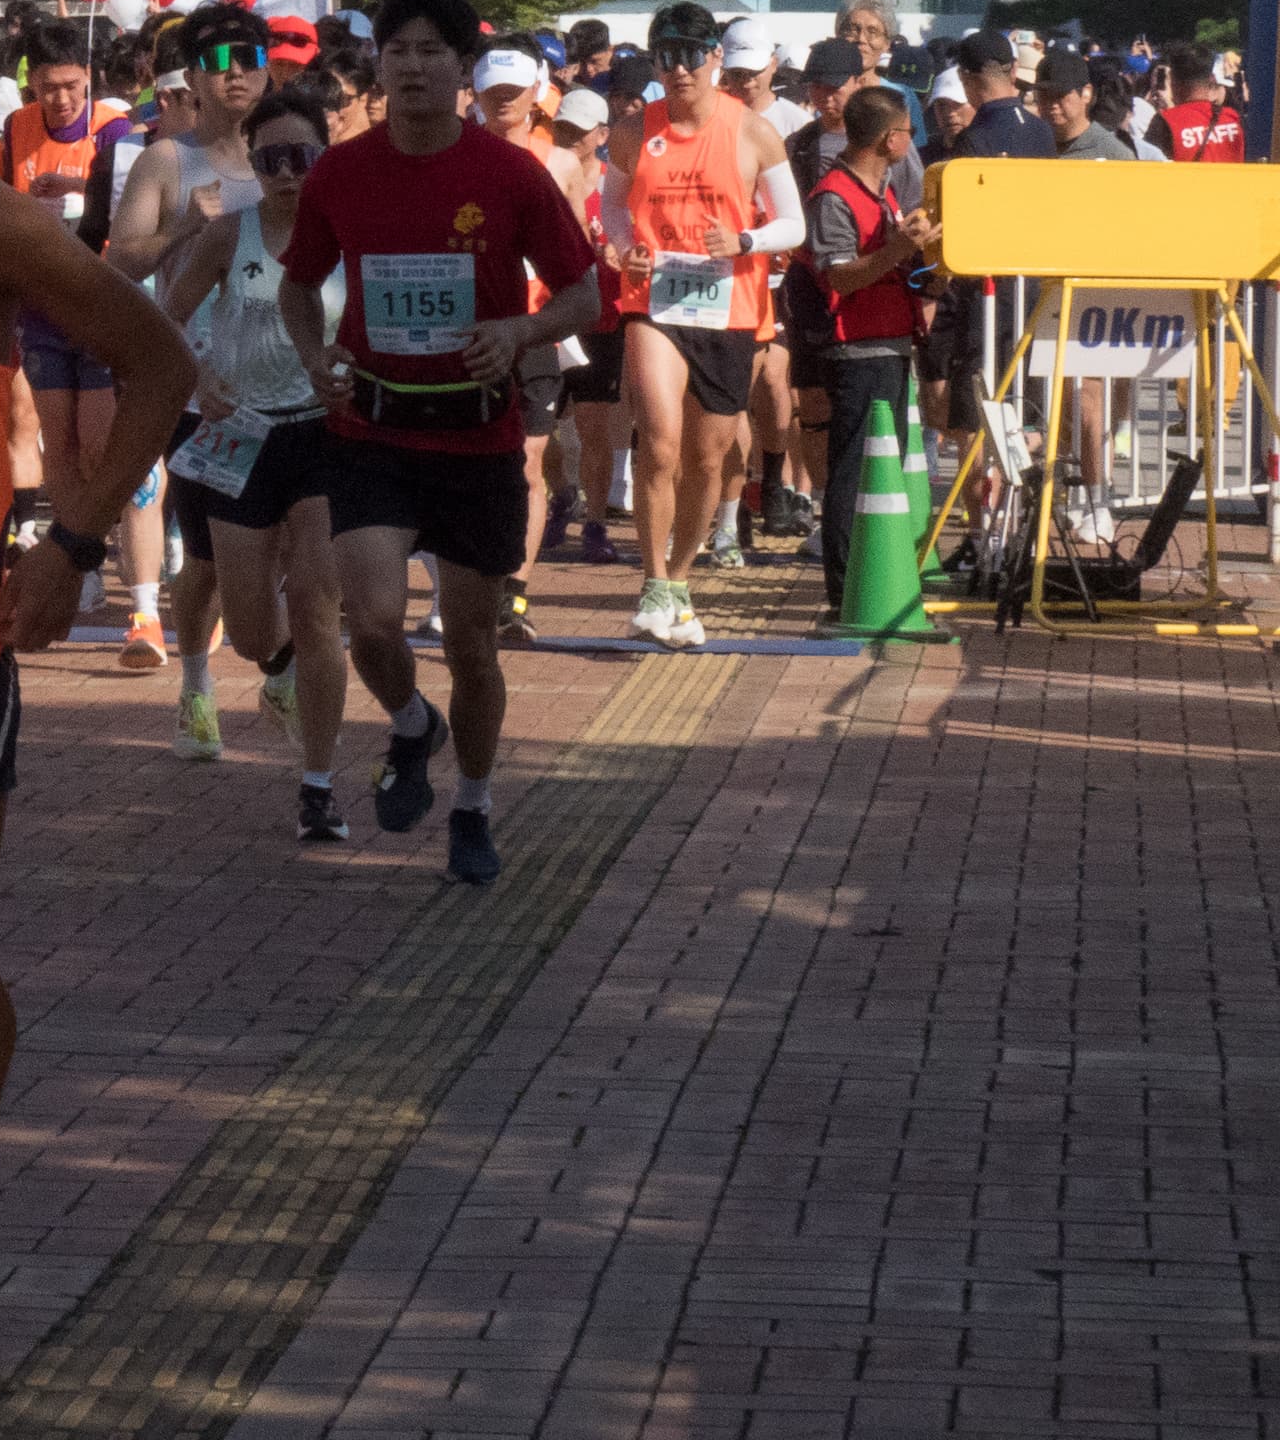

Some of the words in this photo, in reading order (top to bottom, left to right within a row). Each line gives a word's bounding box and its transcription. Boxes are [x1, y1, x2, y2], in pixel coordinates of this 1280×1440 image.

[1181, 122, 1239, 148] STAFF
[660, 224, 707, 242] GUID
[668, 278, 719, 301] 1110
[382, 290, 455, 317] 1155
